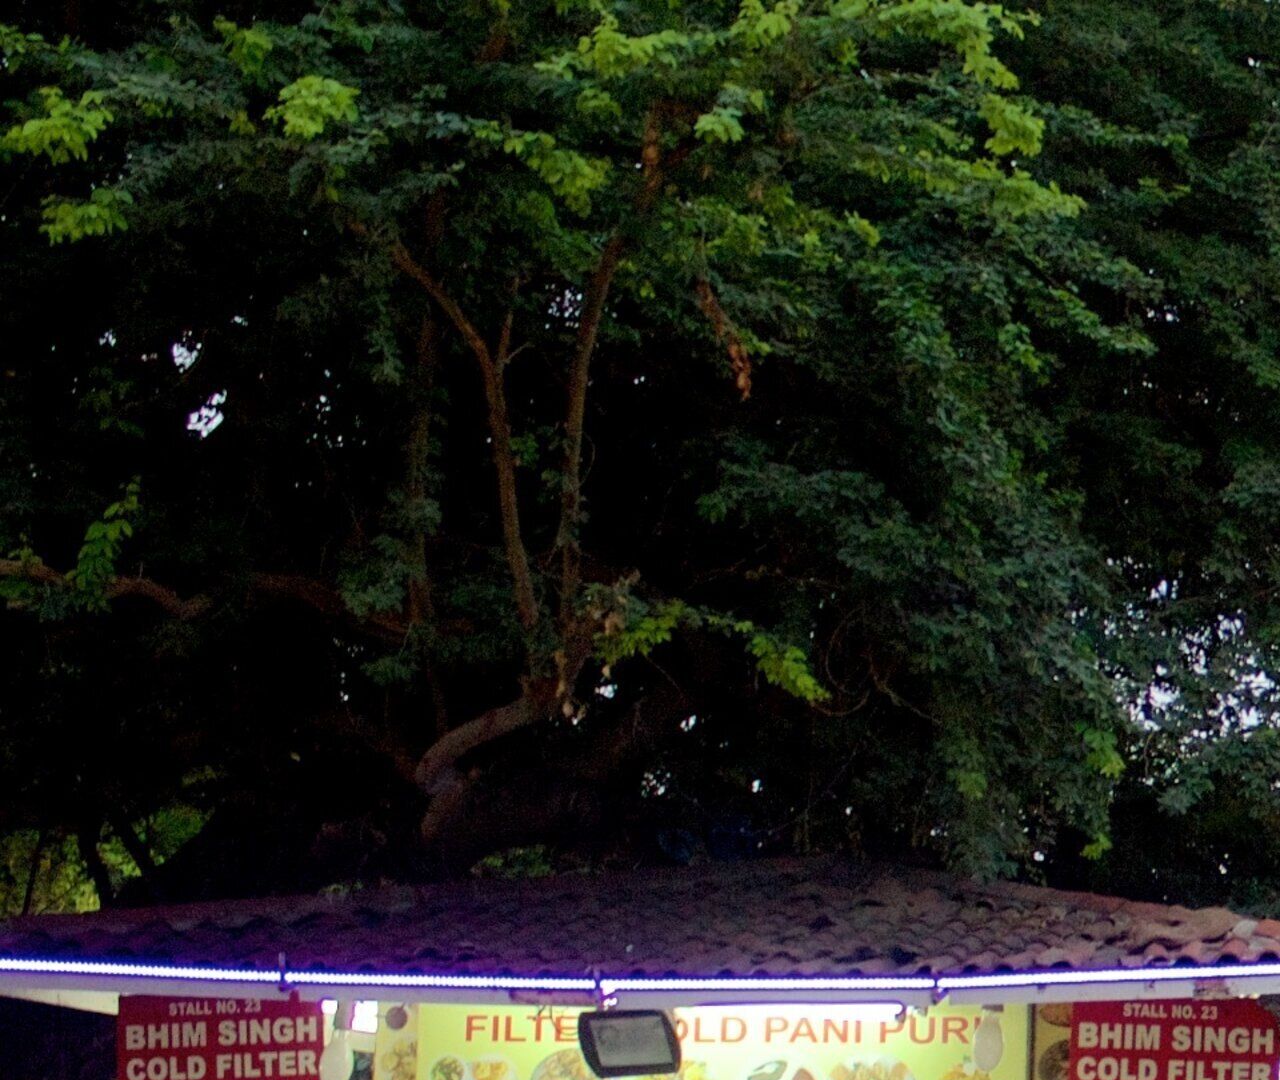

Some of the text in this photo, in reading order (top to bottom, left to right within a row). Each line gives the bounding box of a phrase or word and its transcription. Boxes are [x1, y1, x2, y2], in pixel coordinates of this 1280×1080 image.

[169, 999, 262, 1017] STALL NO. 23
[1122, 1003, 1218, 1020] STALL NO. 23
[125, 1016, 318, 1050] BHIM SINGH
[464, 1014, 580, 1044] FILTE
[676, 1014, 748, 1044] LD
[764, 1016, 862, 1045] PANI
[1077, 1022, 1275, 1055] BHIM SINGH
[216, 1051, 318, 1079] FILTER
